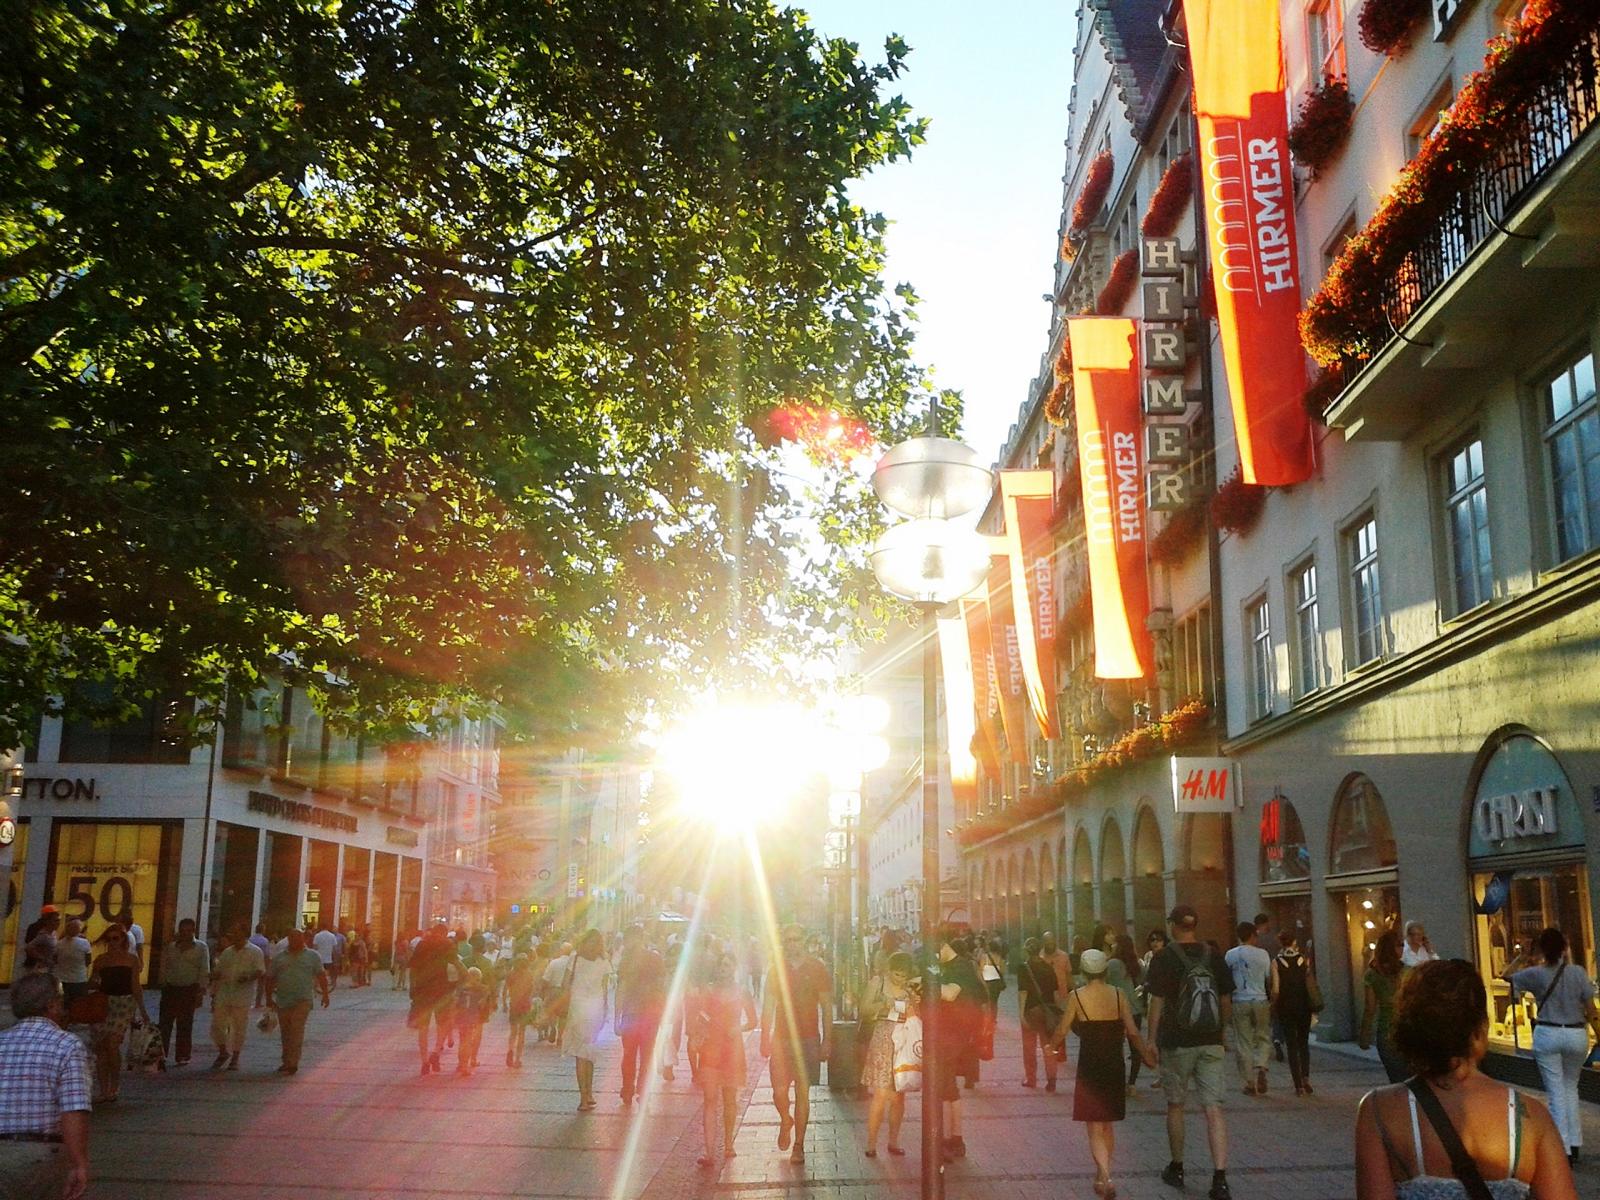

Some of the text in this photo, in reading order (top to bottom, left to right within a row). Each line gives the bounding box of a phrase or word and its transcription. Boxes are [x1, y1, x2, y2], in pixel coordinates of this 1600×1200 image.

[1248, 137, 1294, 293] HIRMER
[1146, 240, 1184, 504] HIRMER
[1114, 431, 1141, 543] HIRMER
[1035, 556, 1056, 640] HIRMER
[1181, 768, 1229, 801] H&M
[65, 876, 133, 927] 50
